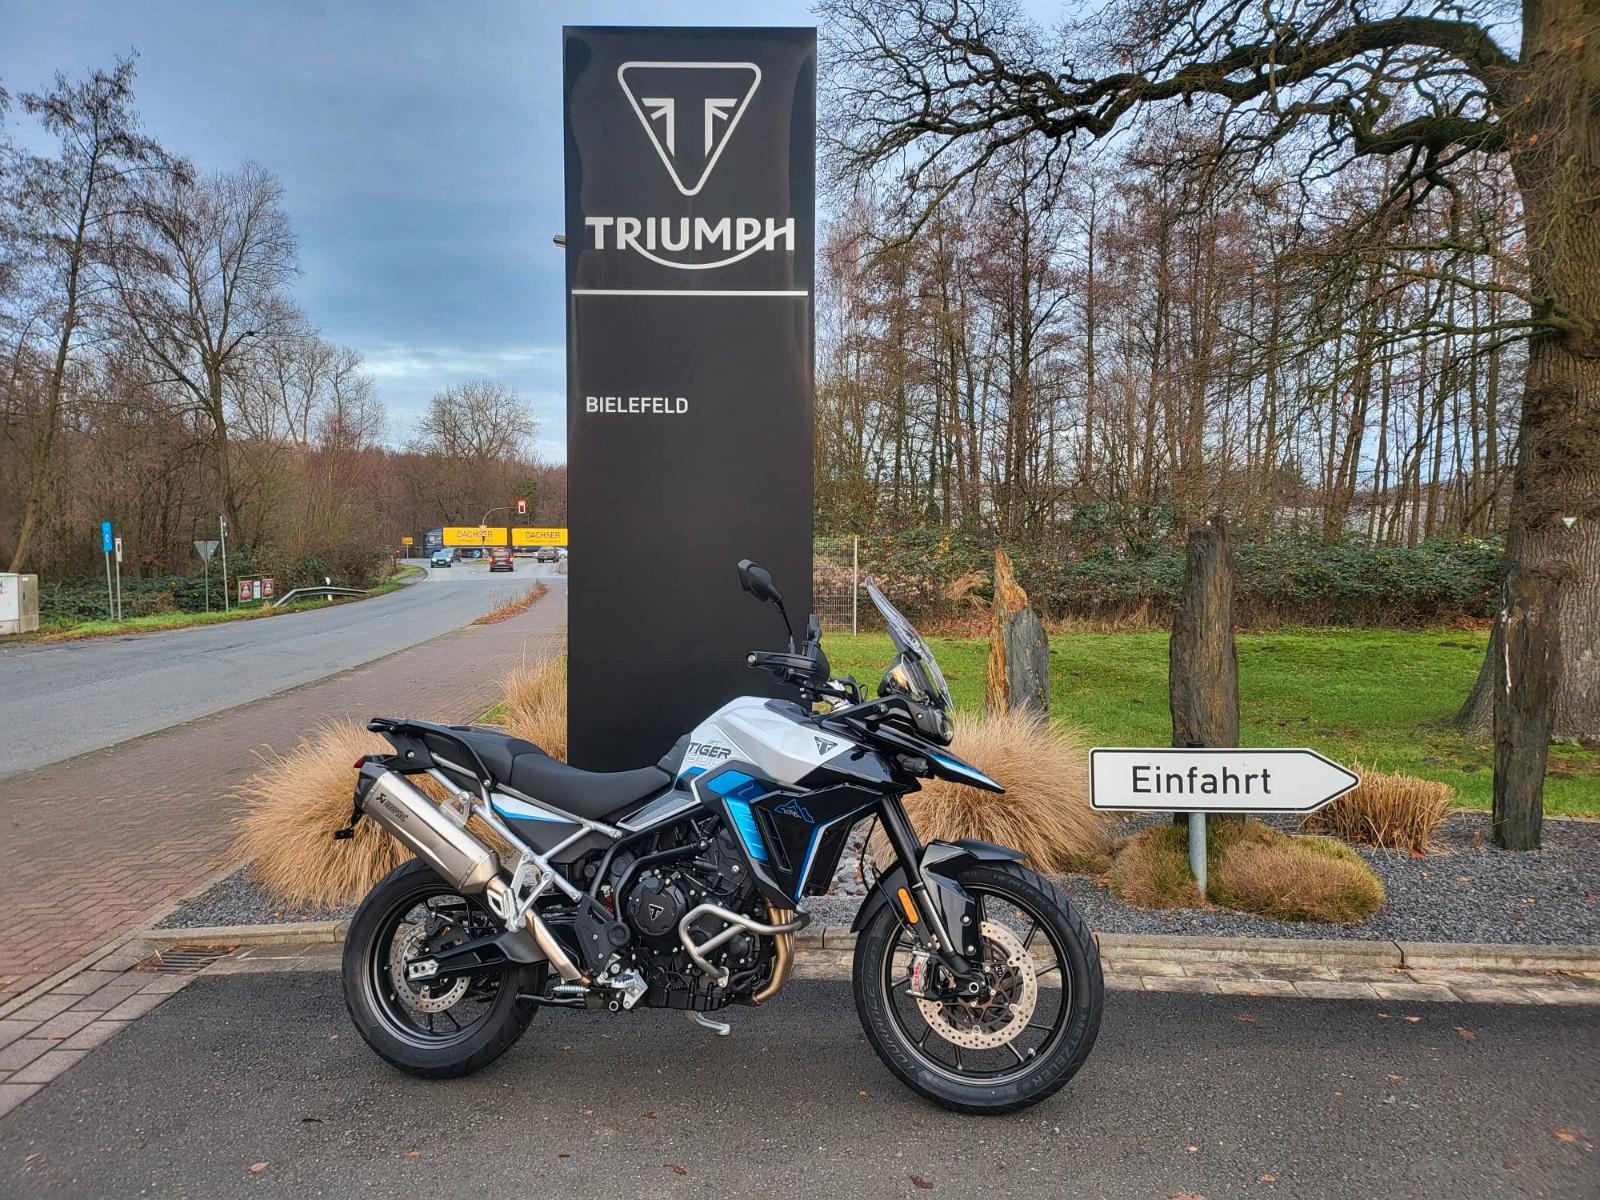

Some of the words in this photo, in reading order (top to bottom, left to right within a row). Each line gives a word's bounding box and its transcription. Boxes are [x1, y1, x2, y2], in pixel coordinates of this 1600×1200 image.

[585, 216, 795, 269] TRIUMPH
[585, 396, 689, 414] BIELEFELD
[525, 531, 560, 539] DACHSER
[688, 742, 732, 759] TIGER
[1131, 765, 1272, 794] Einfahrt
